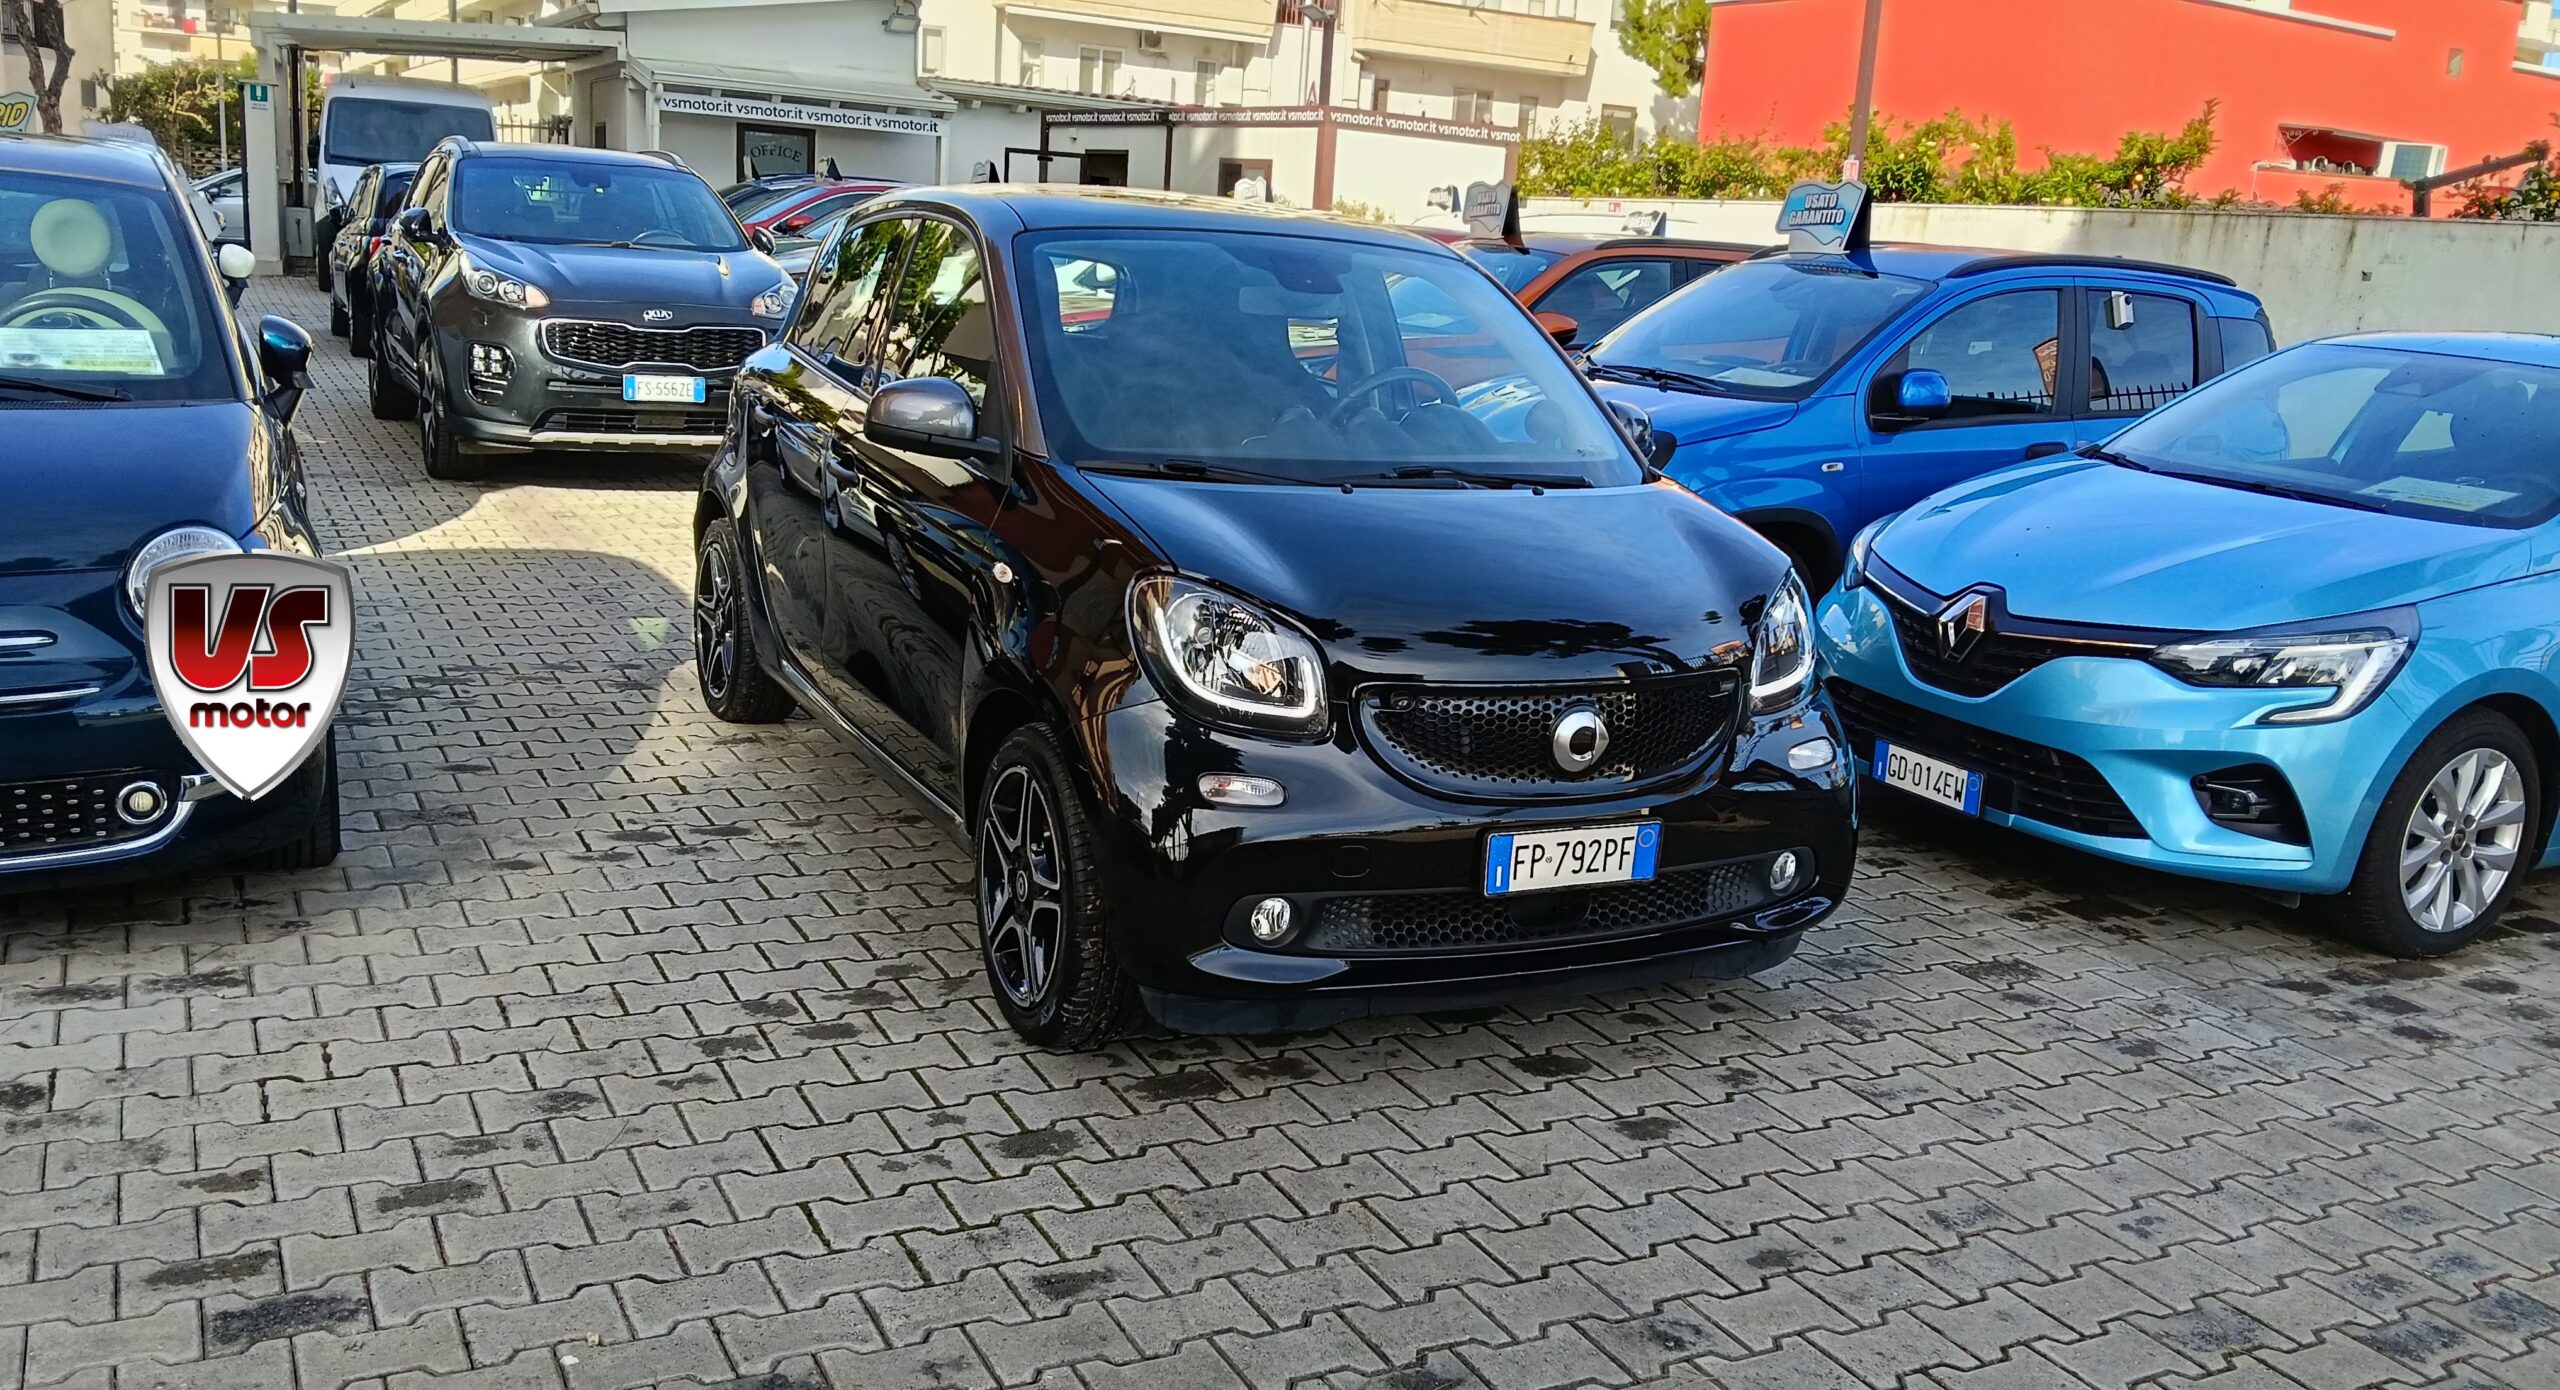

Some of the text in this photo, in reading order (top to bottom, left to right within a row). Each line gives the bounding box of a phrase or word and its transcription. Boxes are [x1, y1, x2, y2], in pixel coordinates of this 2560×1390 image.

[663, 97, 938, 132] vsmotor.it vsmotor.it vsmotor.it vsmotor.it
[1046, 111, 1071, 122] vsmotor.it
[1072, 111, 1098, 122] vsmotor.it
[1099, 111, 1126, 122] vsmotor.it
[1127, 111, 1155, 122] vsmotor.it
[1187, 110, 1218, 121] vsmotor.it
[1252, 109, 1287, 121] vsmotor.it
[1288, 108, 1324, 121] vsmotor.it
[1330, 110, 1383, 127] vsmotor.it
[1385, 118, 1437, 134] vsmotor.it
[1438, 124, 1489, 140] vsmotor.it
[750, 144, 802, 163] OFFICE
[1804, 193, 1838, 209] USATO
[1789, 209, 1844, 226] GARANTITO
